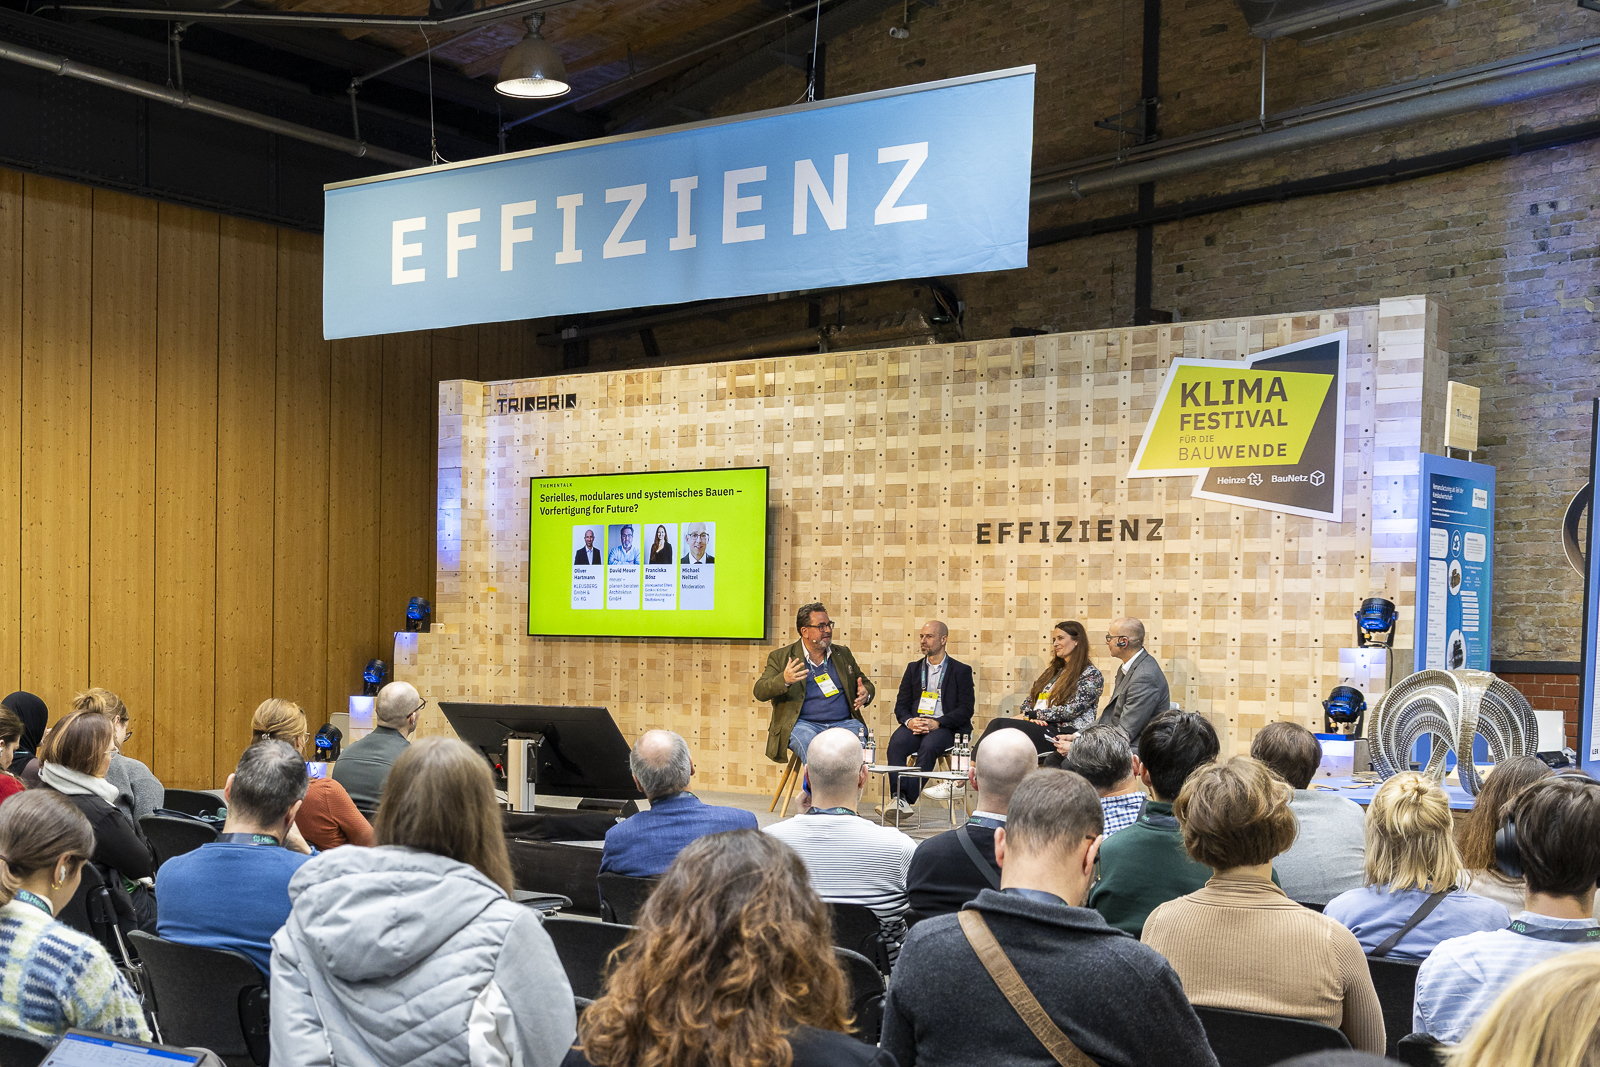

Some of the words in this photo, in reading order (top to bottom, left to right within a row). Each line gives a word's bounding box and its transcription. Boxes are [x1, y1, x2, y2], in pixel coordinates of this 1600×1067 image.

[391, 141, 930, 286] EFFIZIENZ
[1180, 376, 1288, 408] KLIMA
[1179, 408, 1288, 431] FESTIVAL
[1179, 434, 1197, 444] FÜR
[1199, 434, 1215, 443] DIE
[1178, 443, 1288, 461] BAUWENDE
[1217, 475, 1246, 485] Heinze
[1271, 473, 1308, 483] BauNetz
[540, 492, 578, 503] Serielles,
[579, 491, 624, 501] modulares
[626, 489, 642, 499] und
[644, 488, 704, 501] systemisches
[705, 487, 734, 497] Bauen
[540, 506, 591, 517] Vorfertigung
[592, 504, 604, 513] for
[606, 503, 639, 513] Future?
[976, 518, 1164, 544] EFFIZIENZ
